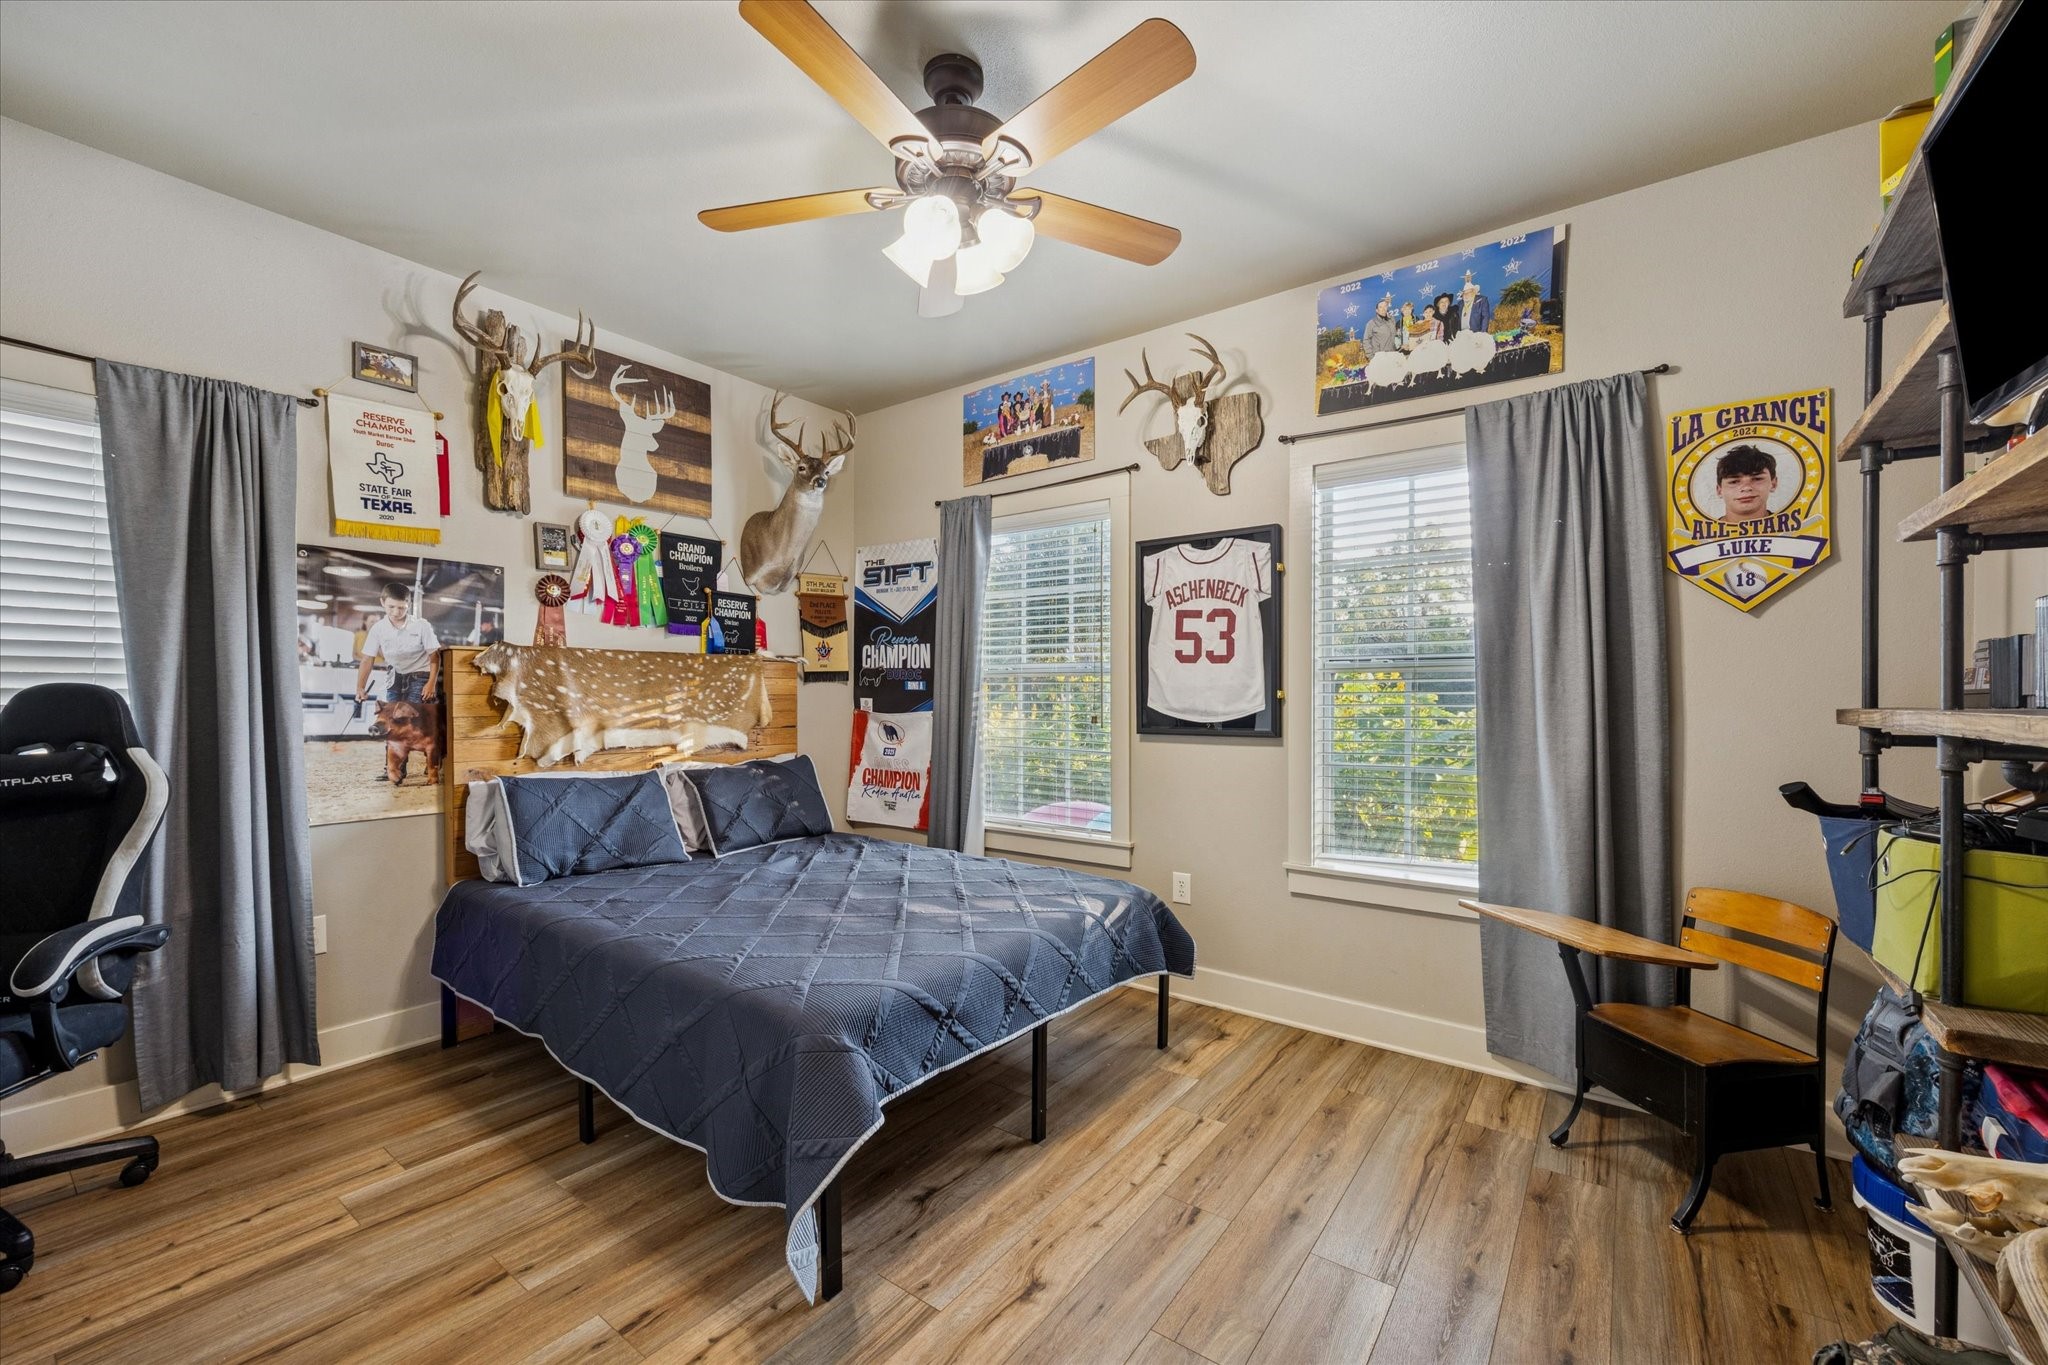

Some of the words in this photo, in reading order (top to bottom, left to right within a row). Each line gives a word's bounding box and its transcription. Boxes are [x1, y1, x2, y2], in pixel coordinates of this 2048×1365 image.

[1500, 234, 1526, 248] 2022
[1416, 260, 1439, 273] 2022
[1340, 282, 1361, 294] 2022
[363, 412, 406, 426] RESERVE
[1672, 412, 1704, 456] LA
[1716, 394, 1826, 434] GRANGE
[356, 419, 412, 435] CHAMPION
[1733, 427, 1758, 437] 2024
[376, 440, 394, 448] Duroc
[359, 483, 388, 494] STATE
[391, 487, 412, 498] FAIR
[360, 497, 412, 514] TEXAS
[1692, 508, 1802, 540] ALL-STARS
[677, 542, 705, 554] GRAND
[1718, 538, 1772, 557] LUKE
[669, 550, 713, 565] CHAMPION
[864, 558, 885, 566] THE
[679, 563, 703, 572] Broilers
[863, 560, 934, 588] SIFT
[1736, 572, 1756, 587] 18
[1165, 578, 1250, 610] ASCHENBECK
[718, 598, 748, 610] RESERVE
[714, 609, 751, 620] CHAMPION
[870, 626, 918, 648] Reserve
[1174, 608, 1236, 664] 53
[862, 643, 931, 669] CHAMPION
[887, 669, 922, 680] DUROC
[0, 774, 73, 787] TPLAYER
[862, 768, 920, 791] CHAMPION
[862, 784, 888, 798] Rodeo
[892, 786, 921, 802] Austin
